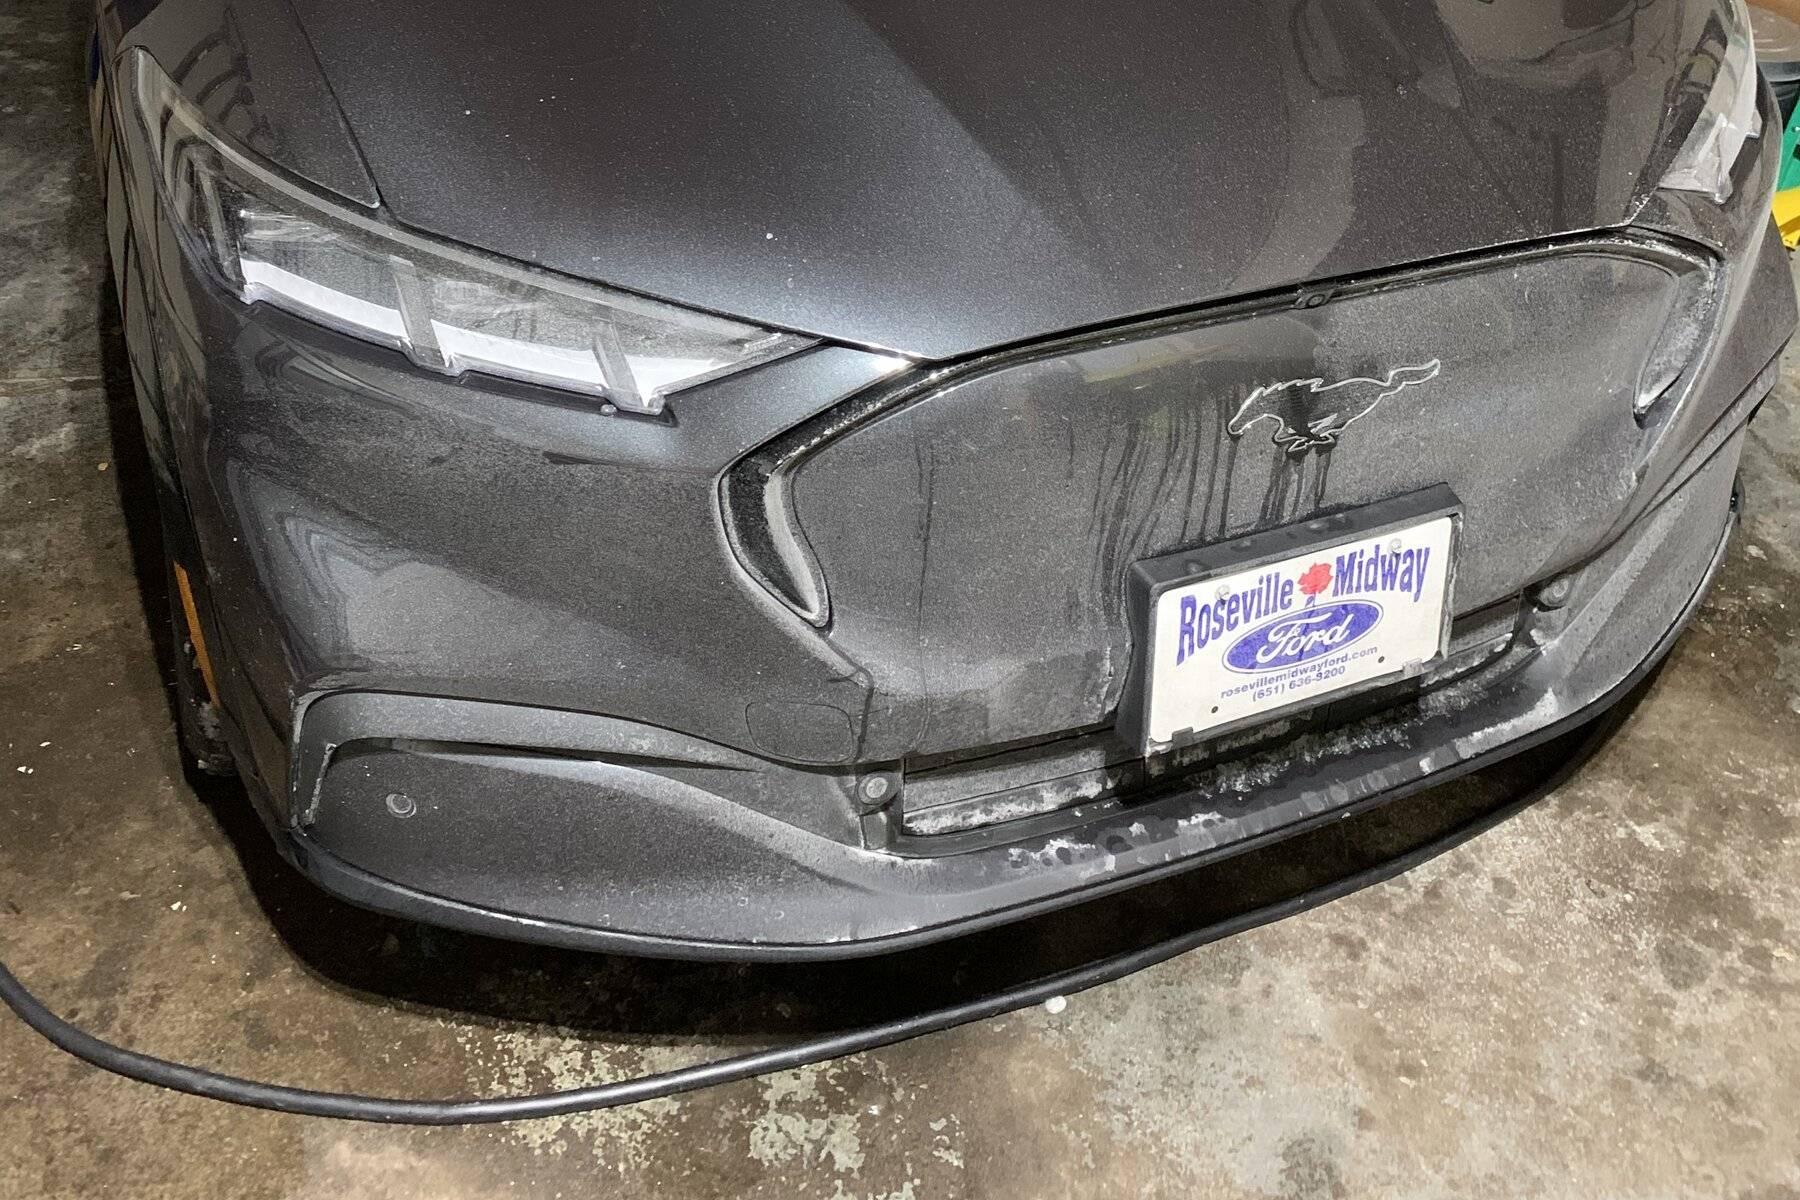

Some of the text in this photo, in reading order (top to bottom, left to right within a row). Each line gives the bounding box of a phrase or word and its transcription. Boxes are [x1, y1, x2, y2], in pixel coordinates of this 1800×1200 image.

[1176, 544, 1431, 667] Roseville Midway
[1255, 612, 1355, 665] Ford
[1220, 645, 1379, 699] rosevillemidwayford.com
[1252, 683, 1286, 702] (651)
